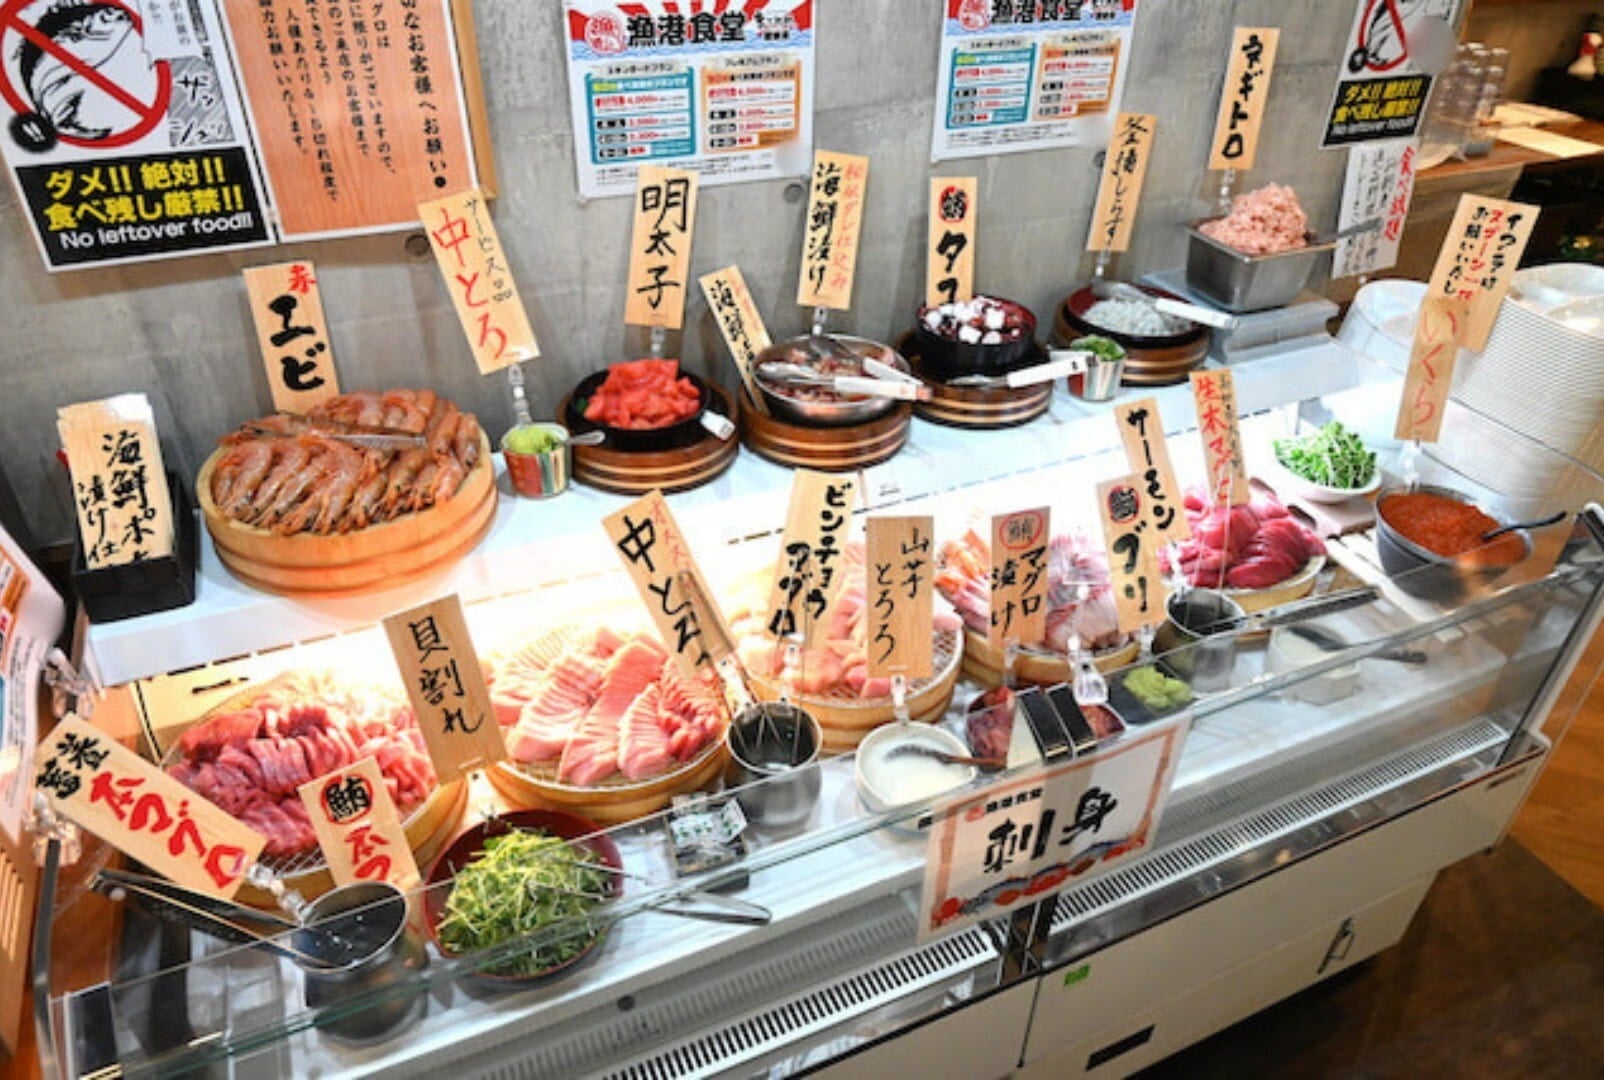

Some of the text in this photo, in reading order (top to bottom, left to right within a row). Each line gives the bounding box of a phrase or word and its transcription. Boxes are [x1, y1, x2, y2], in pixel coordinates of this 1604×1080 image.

[626, 10, 747, 48] 漁港食堂
[1221, 34, 1265, 160] ネギトロ
[60, 230, 96, 250] No
[98, 221, 189, 245] leftover
[432, 207, 516, 361] 中とろ
[637, 177, 692, 310] 明太子
[267, 294, 326, 392] エビ
[1125, 408, 1175, 530] サーモン
[901, 527, 930, 600] 山芋
[1019, 546, 1048, 617] マグロ
[1112, 520, 1149, 613] ブリ
[873, 562, 895, 665] とろろ
[408, 615, 487, 736] 貝割れ
[983, 786, 1118, 874] 刺身
